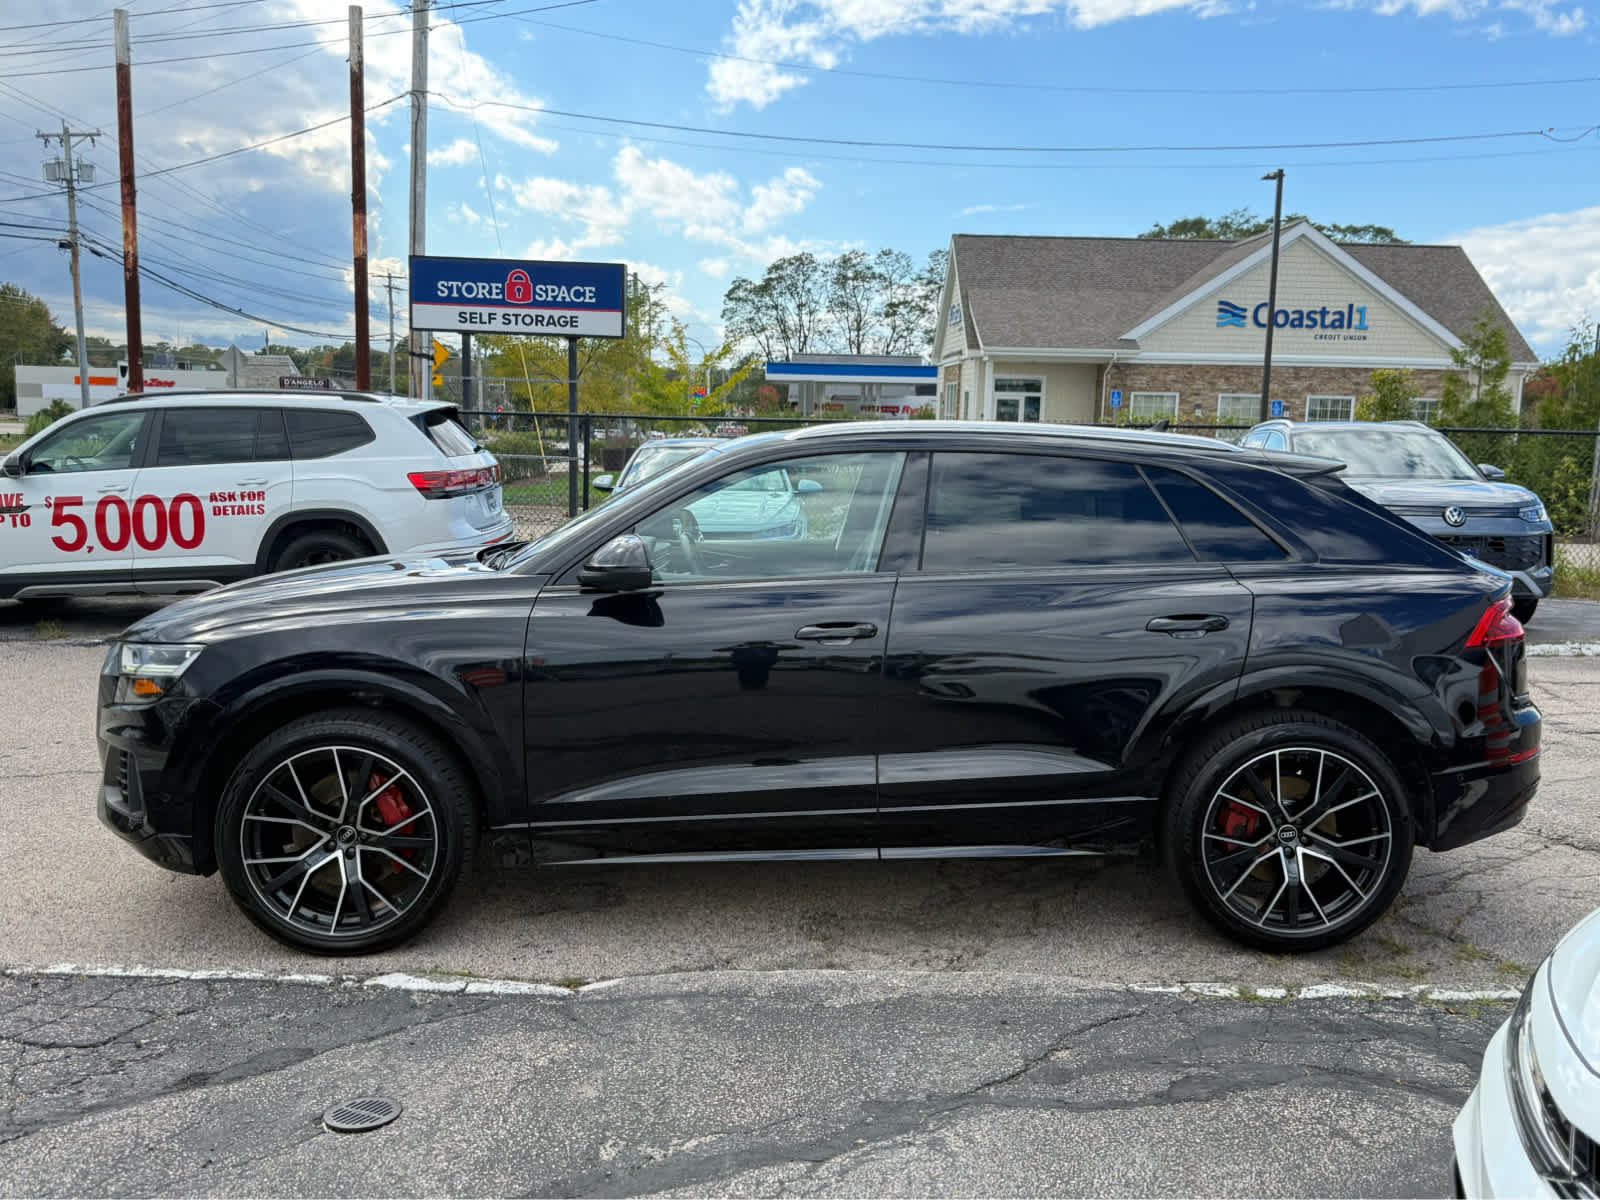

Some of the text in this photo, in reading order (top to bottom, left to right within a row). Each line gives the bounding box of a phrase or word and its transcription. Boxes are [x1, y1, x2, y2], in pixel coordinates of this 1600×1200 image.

[437, 280, 596, 303] STORE SPACE
[458, 311, 579, 328] SELF STORAGE
[209, 491, 265, 503] ASK FOR
[212, 504, 265, 516] DETAILS
[9, 513, 31, 528] TO
